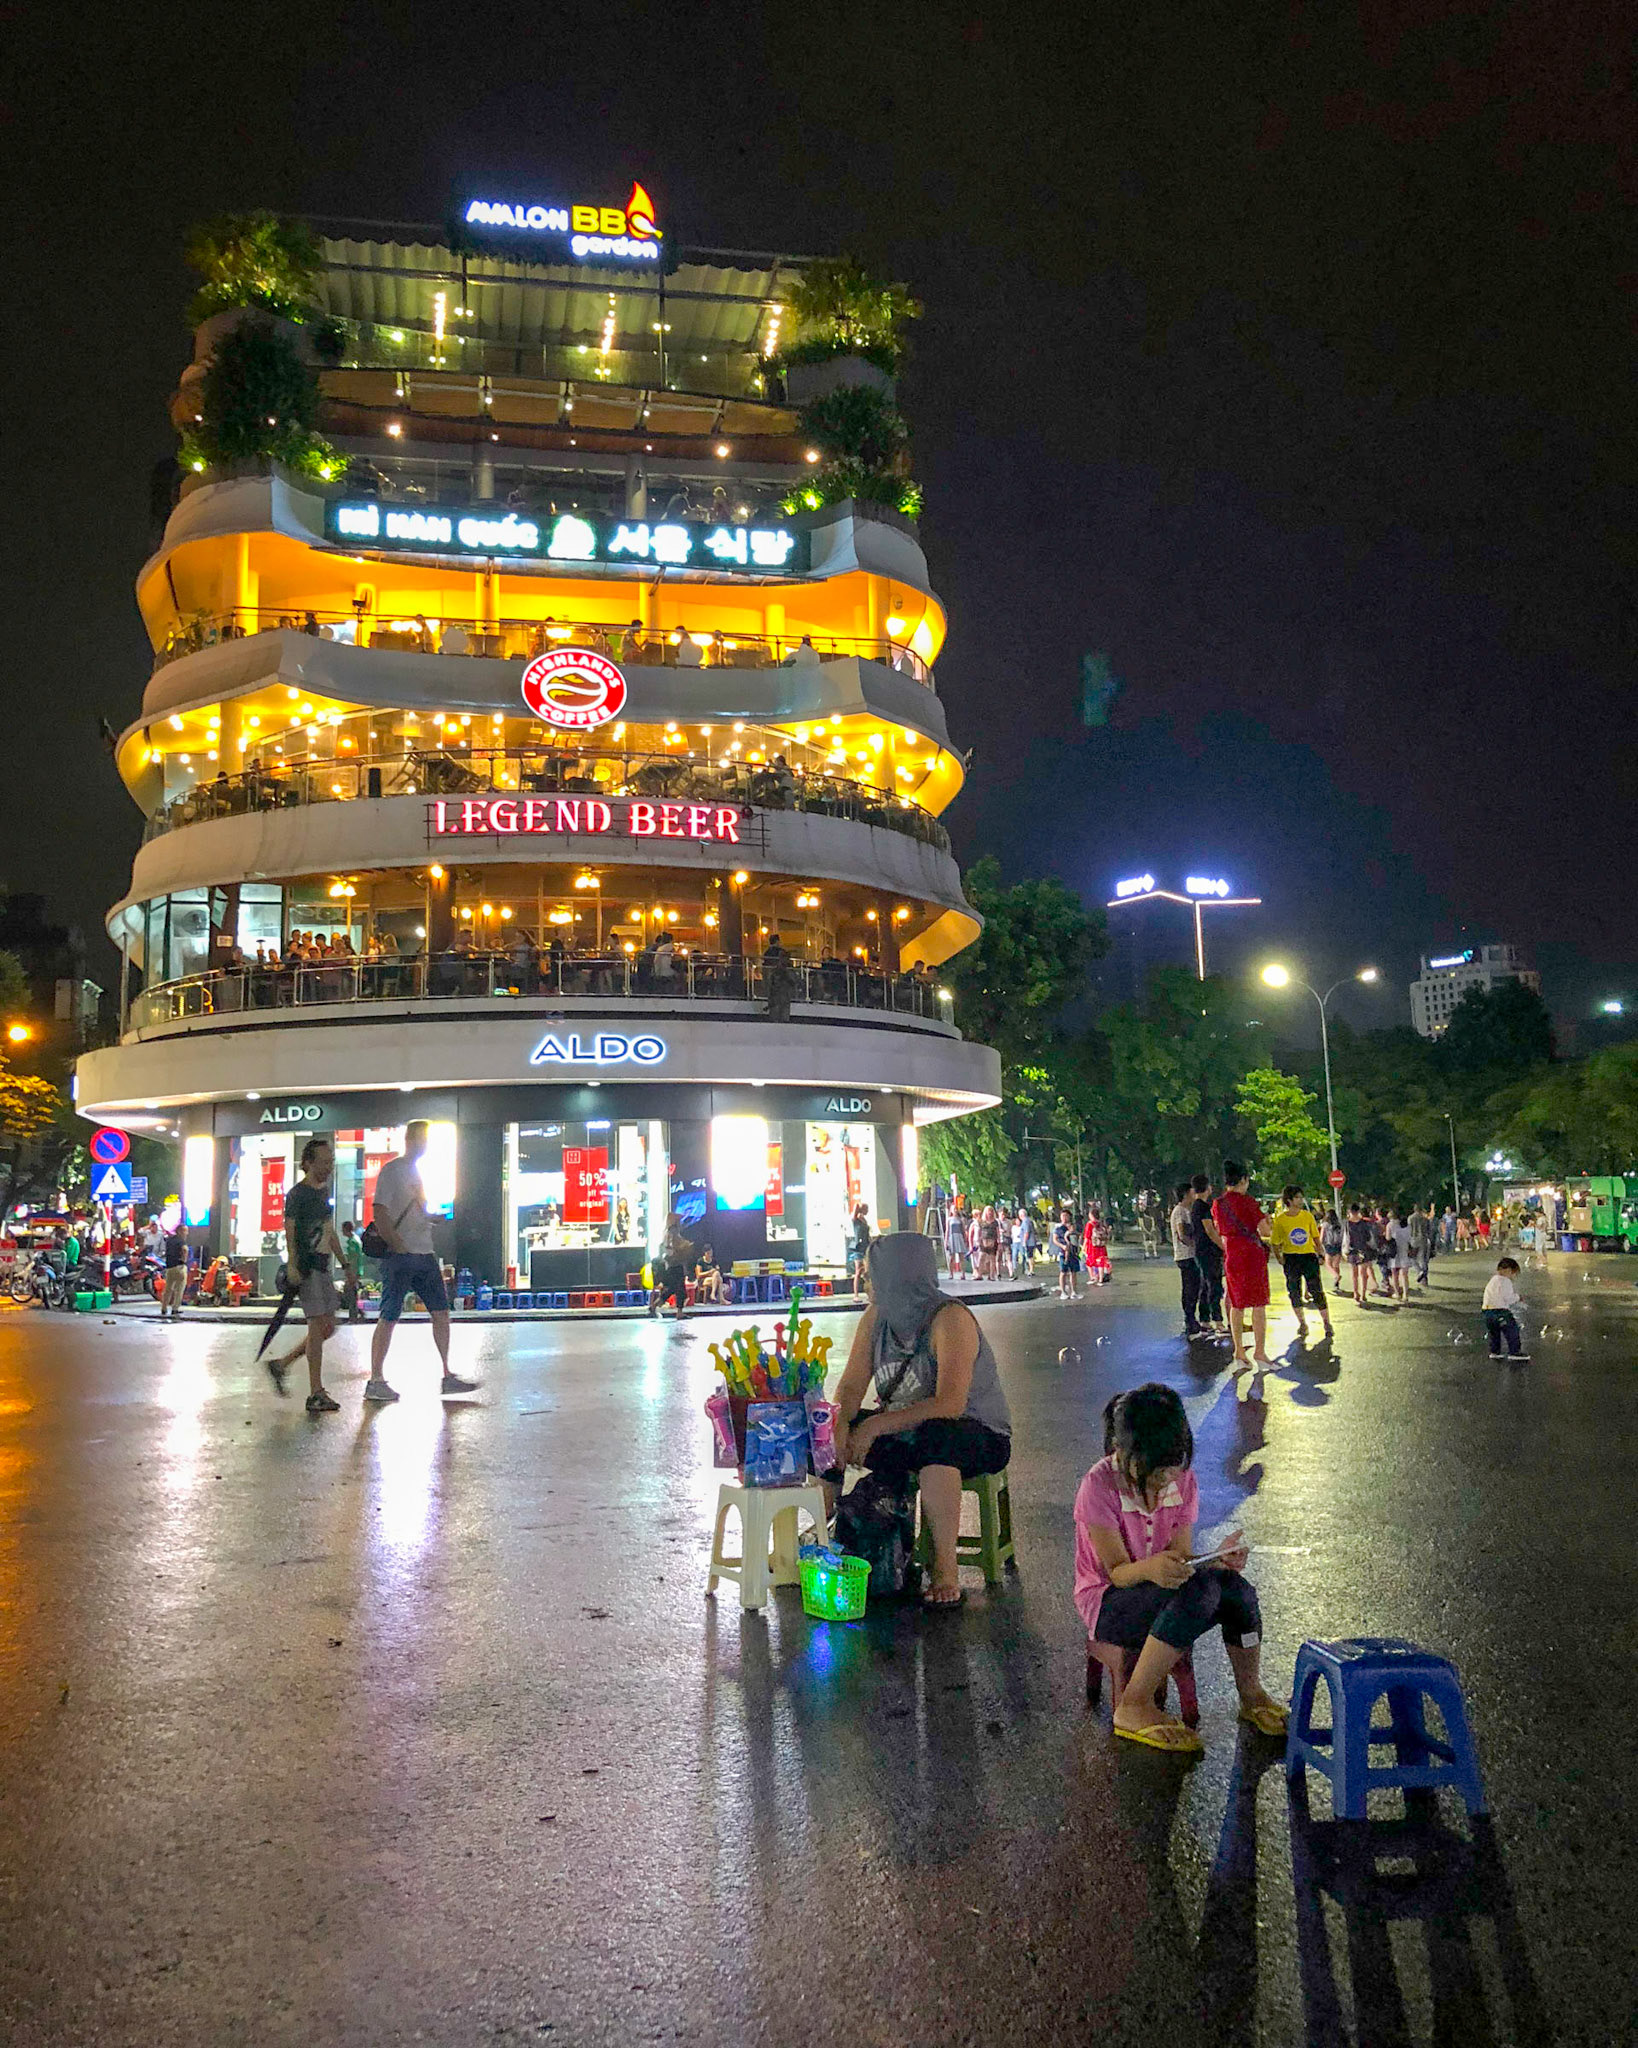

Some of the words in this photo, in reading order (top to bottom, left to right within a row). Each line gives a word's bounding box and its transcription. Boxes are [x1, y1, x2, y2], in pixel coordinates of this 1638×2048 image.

[465, 200, 569, 232] AVALON
[526, 650, 621, 690] HIGHLANDS
[538, 703, 612, 725] COFFEE
[435, 800, 612, 834] LEGEND
[629, 802, 740, 844] BEER
[531, 1035, 666, 1065] ALDO
[259, 1104, 323, 1124] ALDO
[825, 1097, 872, 1114] ALDO
